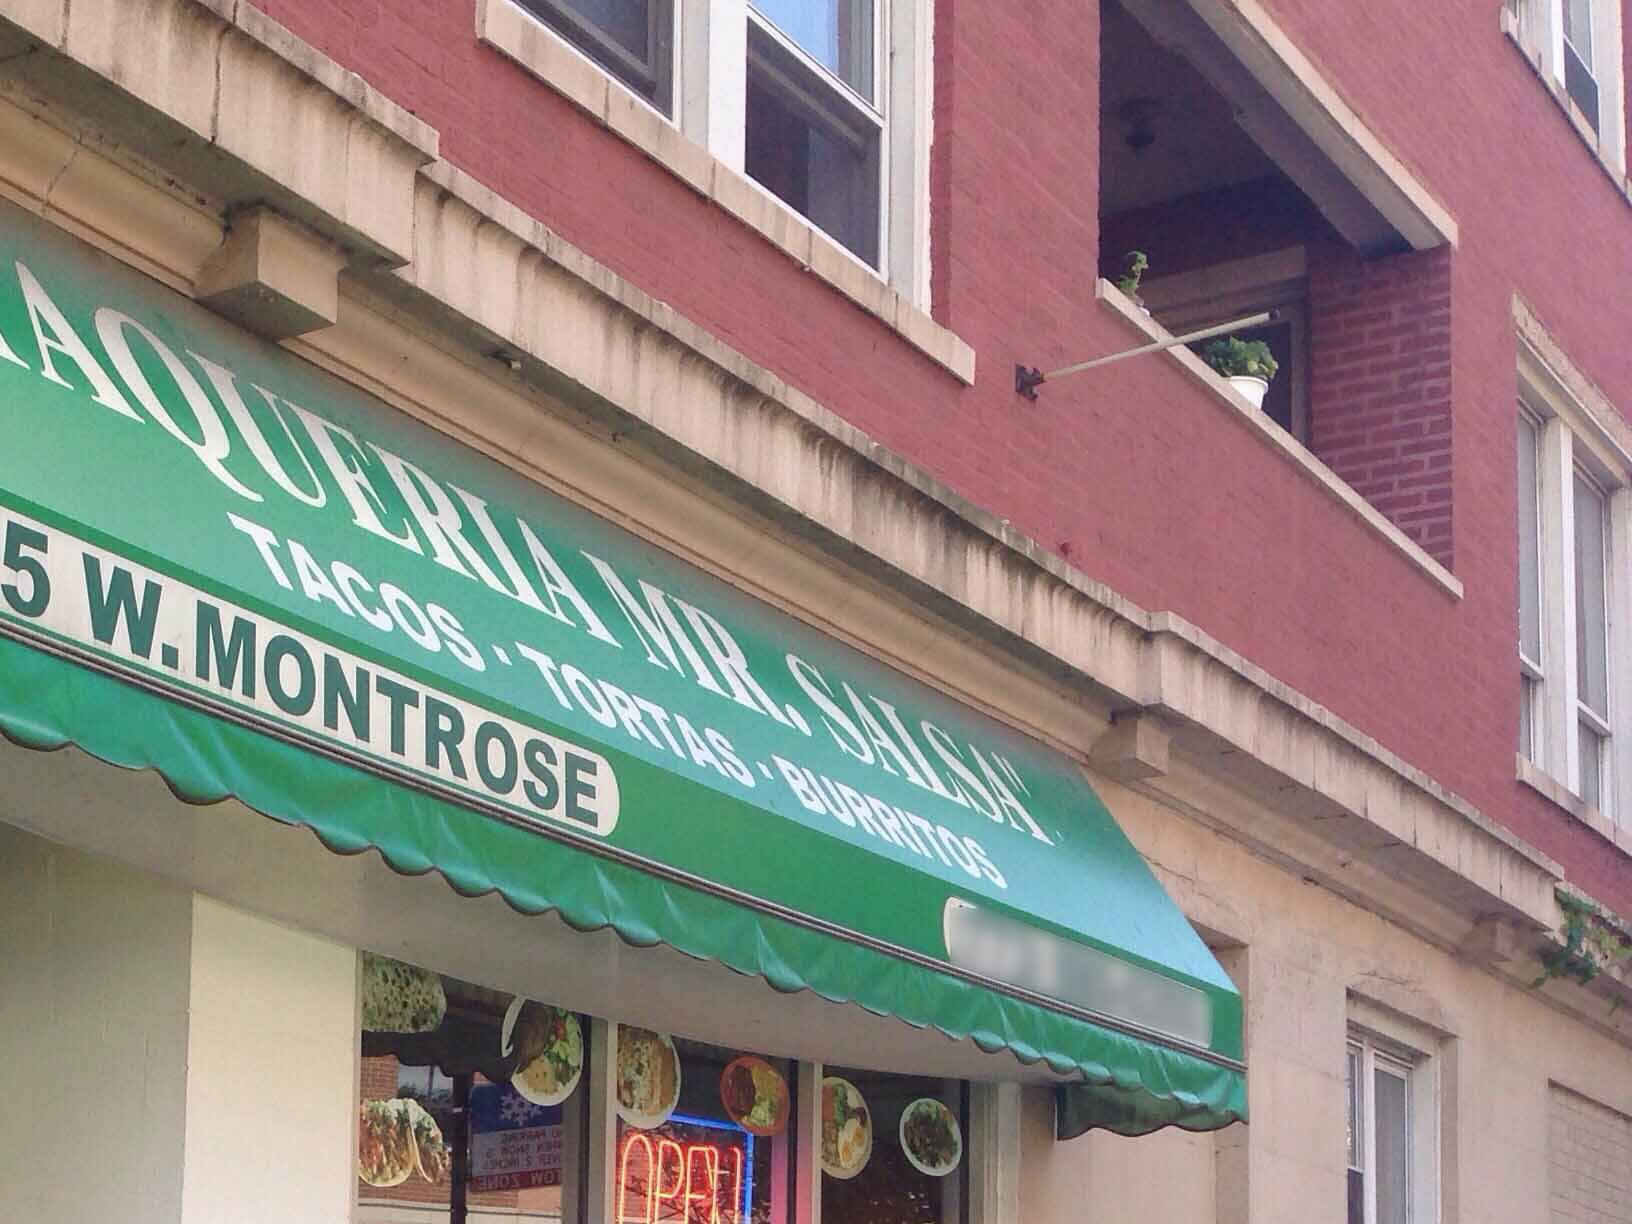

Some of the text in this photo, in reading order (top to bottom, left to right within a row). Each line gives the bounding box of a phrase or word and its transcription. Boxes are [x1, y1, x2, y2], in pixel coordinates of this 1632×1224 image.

[227, 512, 1008, 888] TACOS TORTAS BURRITOS
[580, 549, 812, 736] MR.
